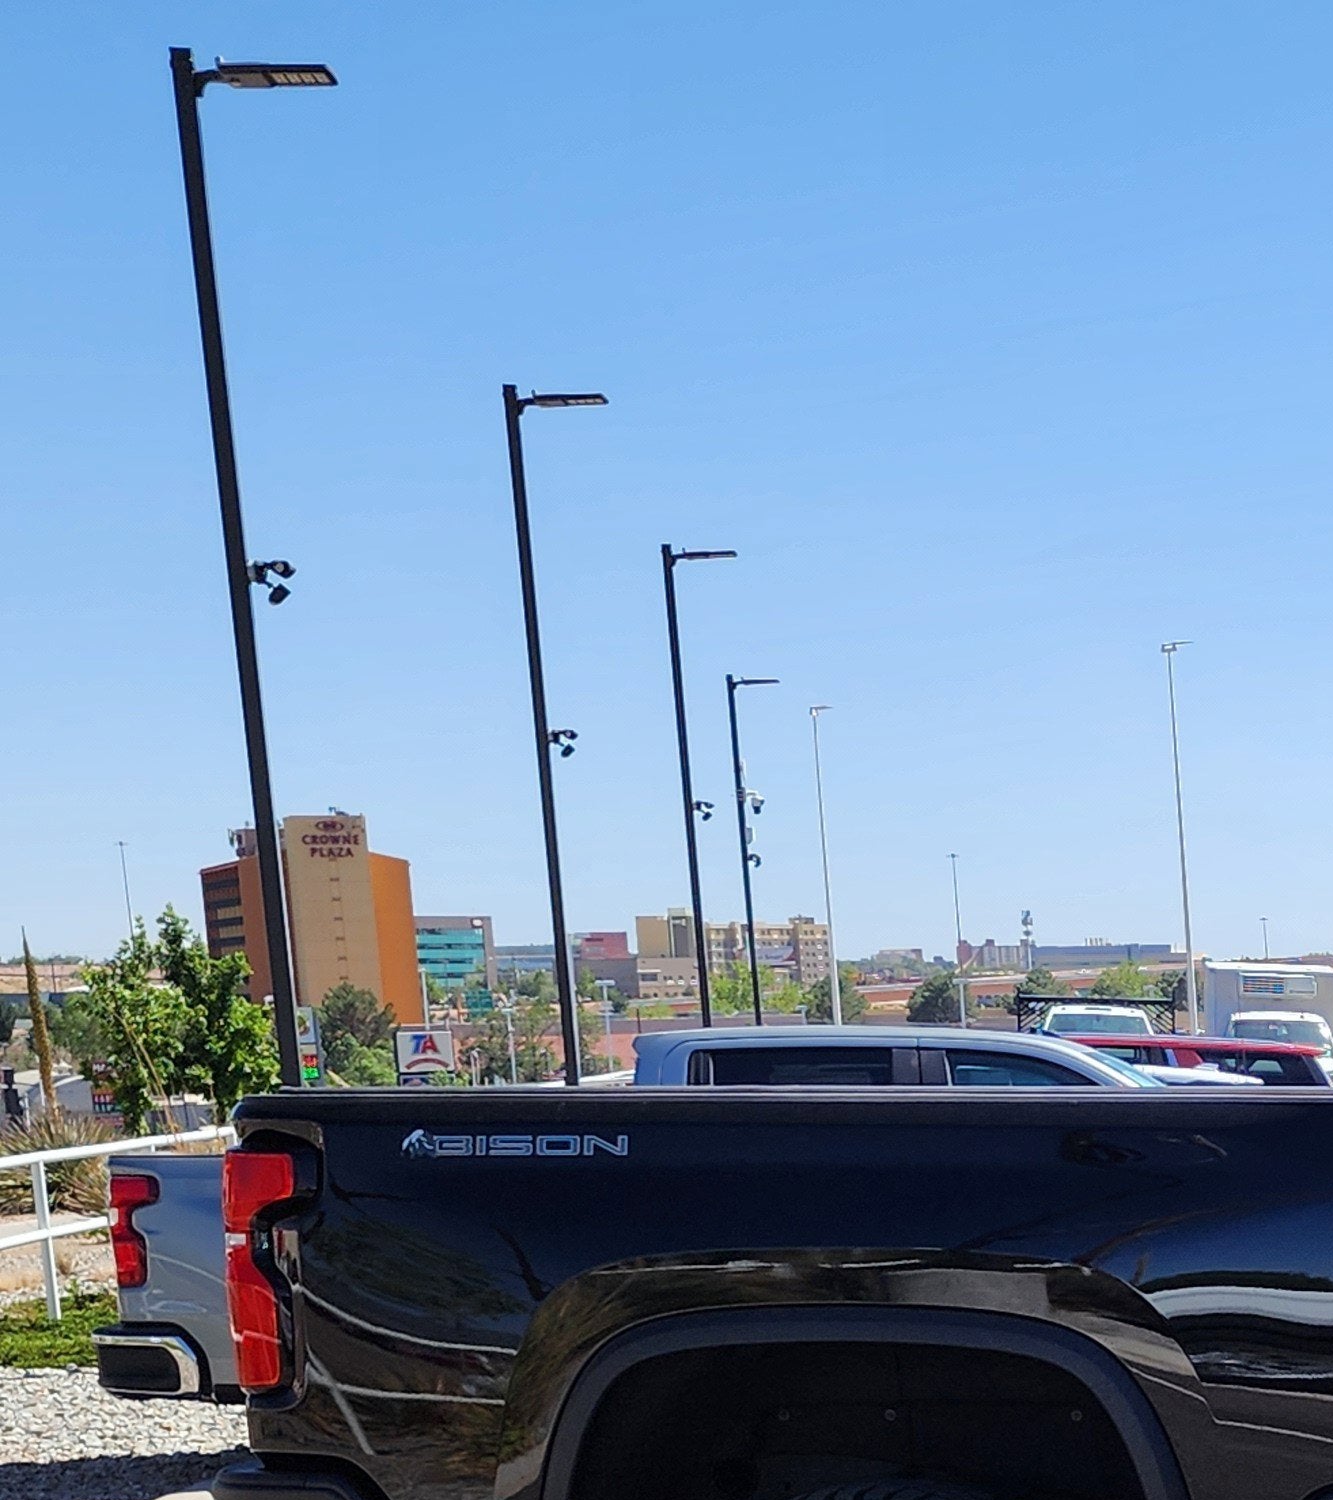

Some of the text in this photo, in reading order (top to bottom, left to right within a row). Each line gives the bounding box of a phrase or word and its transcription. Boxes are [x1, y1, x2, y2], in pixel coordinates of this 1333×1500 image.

[301, 834, 359, 845] CROWNE
[310, 847, 354, 858] PLAZA
[411, 1033, 441, 1054] TA
[433, 1134, 629, 1157] BISON
